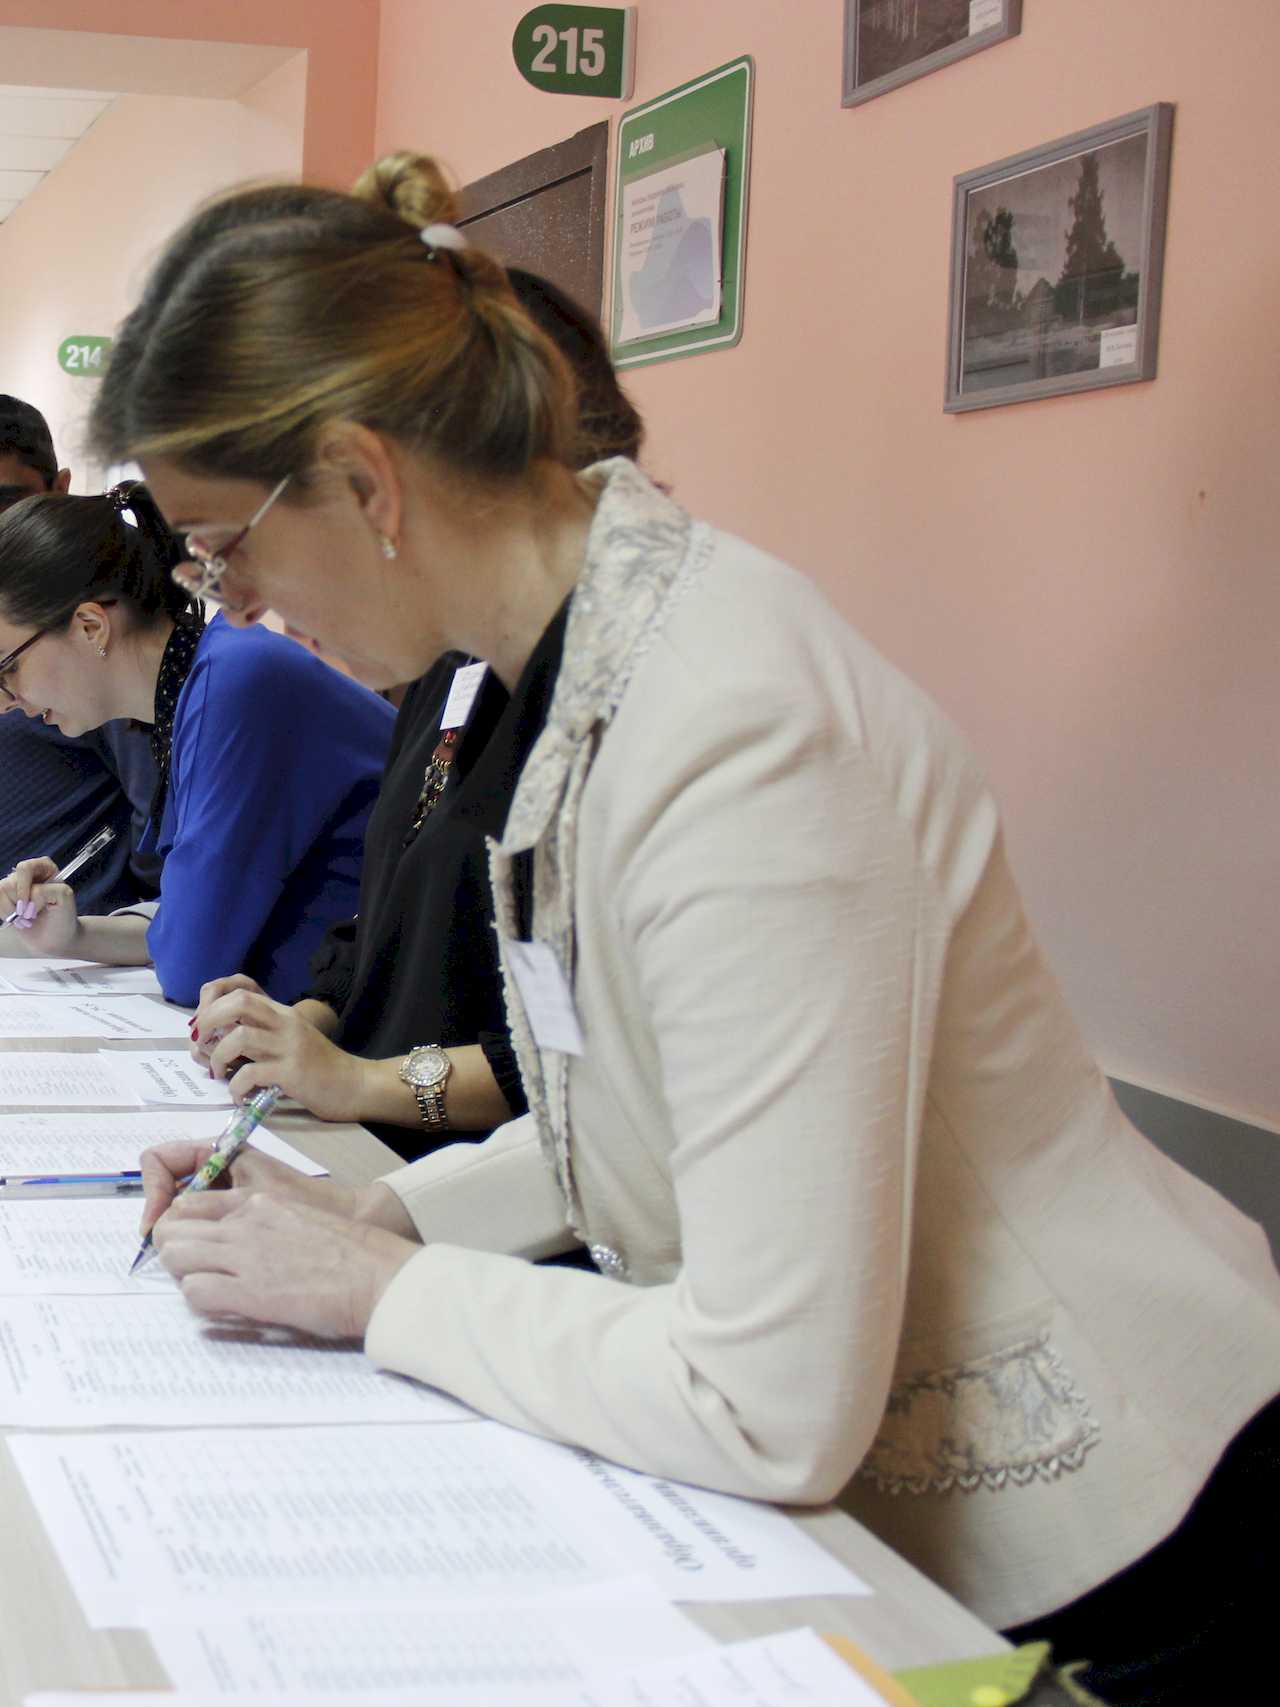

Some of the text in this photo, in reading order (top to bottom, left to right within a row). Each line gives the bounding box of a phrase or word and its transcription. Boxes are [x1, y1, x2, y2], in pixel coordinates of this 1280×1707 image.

[531, 24, 606, 77] 215
[628, 132, 655, 159] АРХИВ
[65, 345, 102, 369] 214
